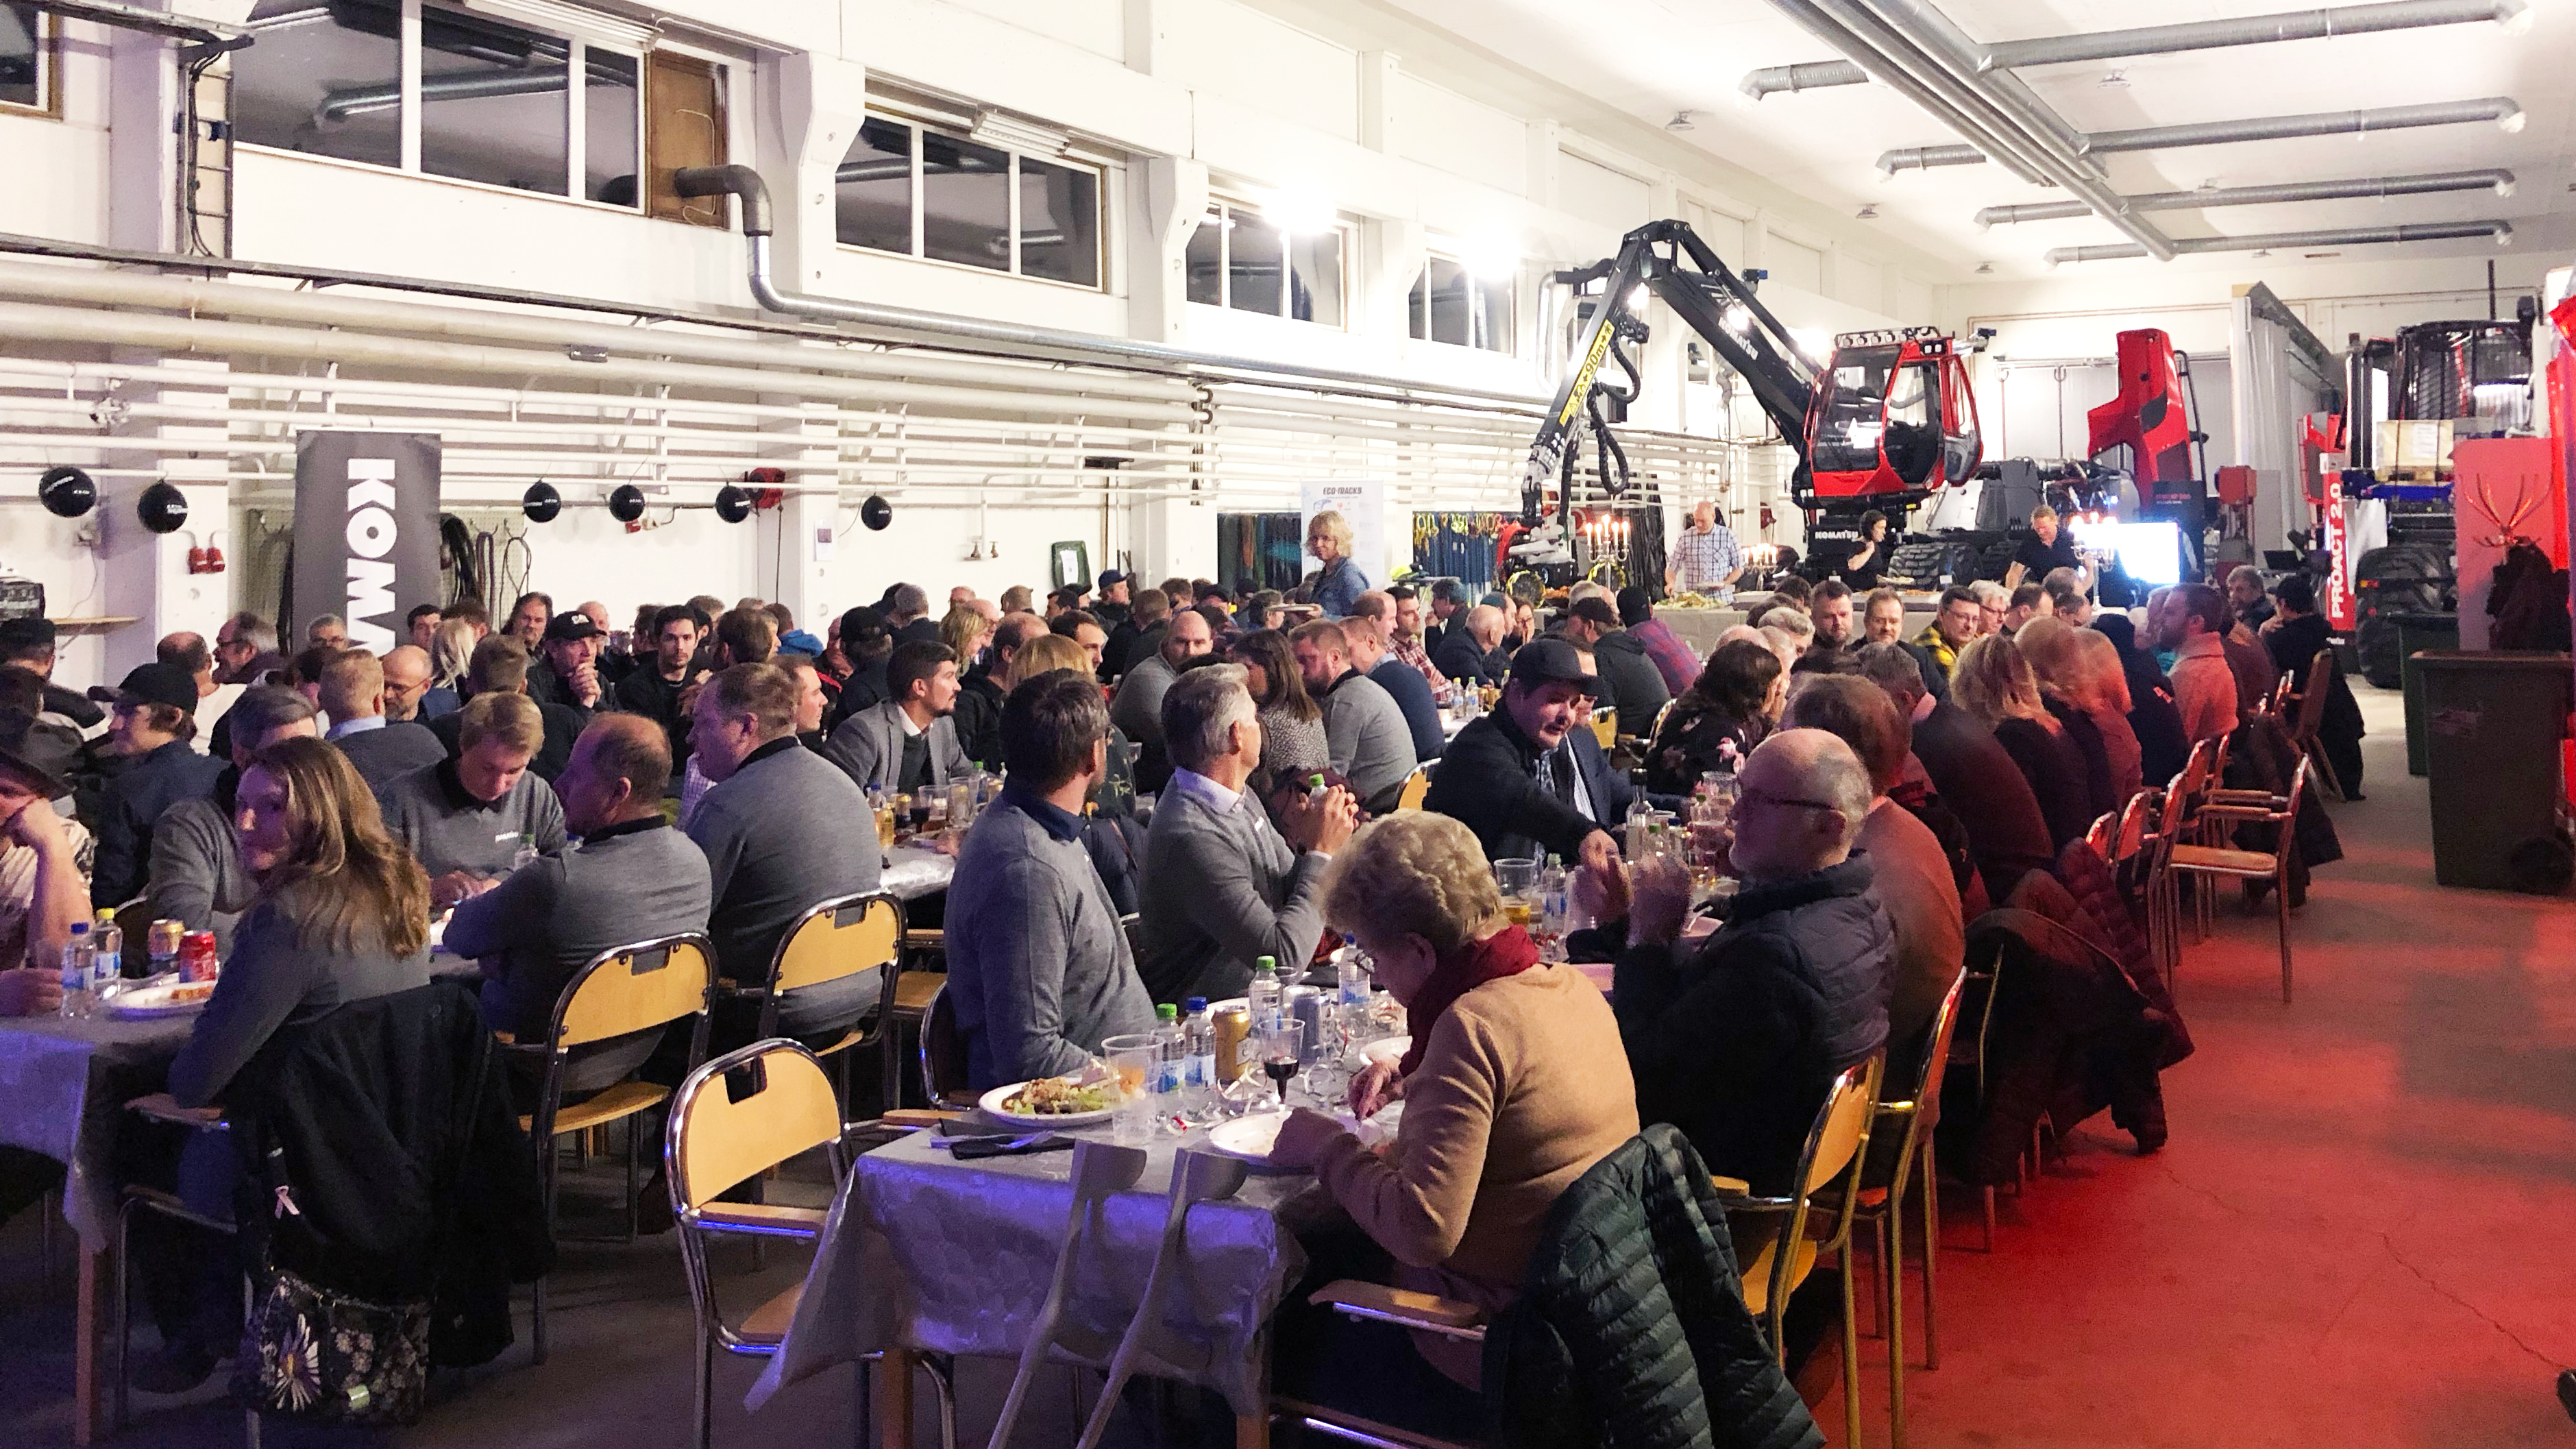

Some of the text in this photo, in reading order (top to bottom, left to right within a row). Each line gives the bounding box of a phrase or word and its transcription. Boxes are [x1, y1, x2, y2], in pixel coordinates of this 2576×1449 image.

[1586, 344, 1604, 375] 90m
[2330, 483, 2344, 618] PROACT 2.0
